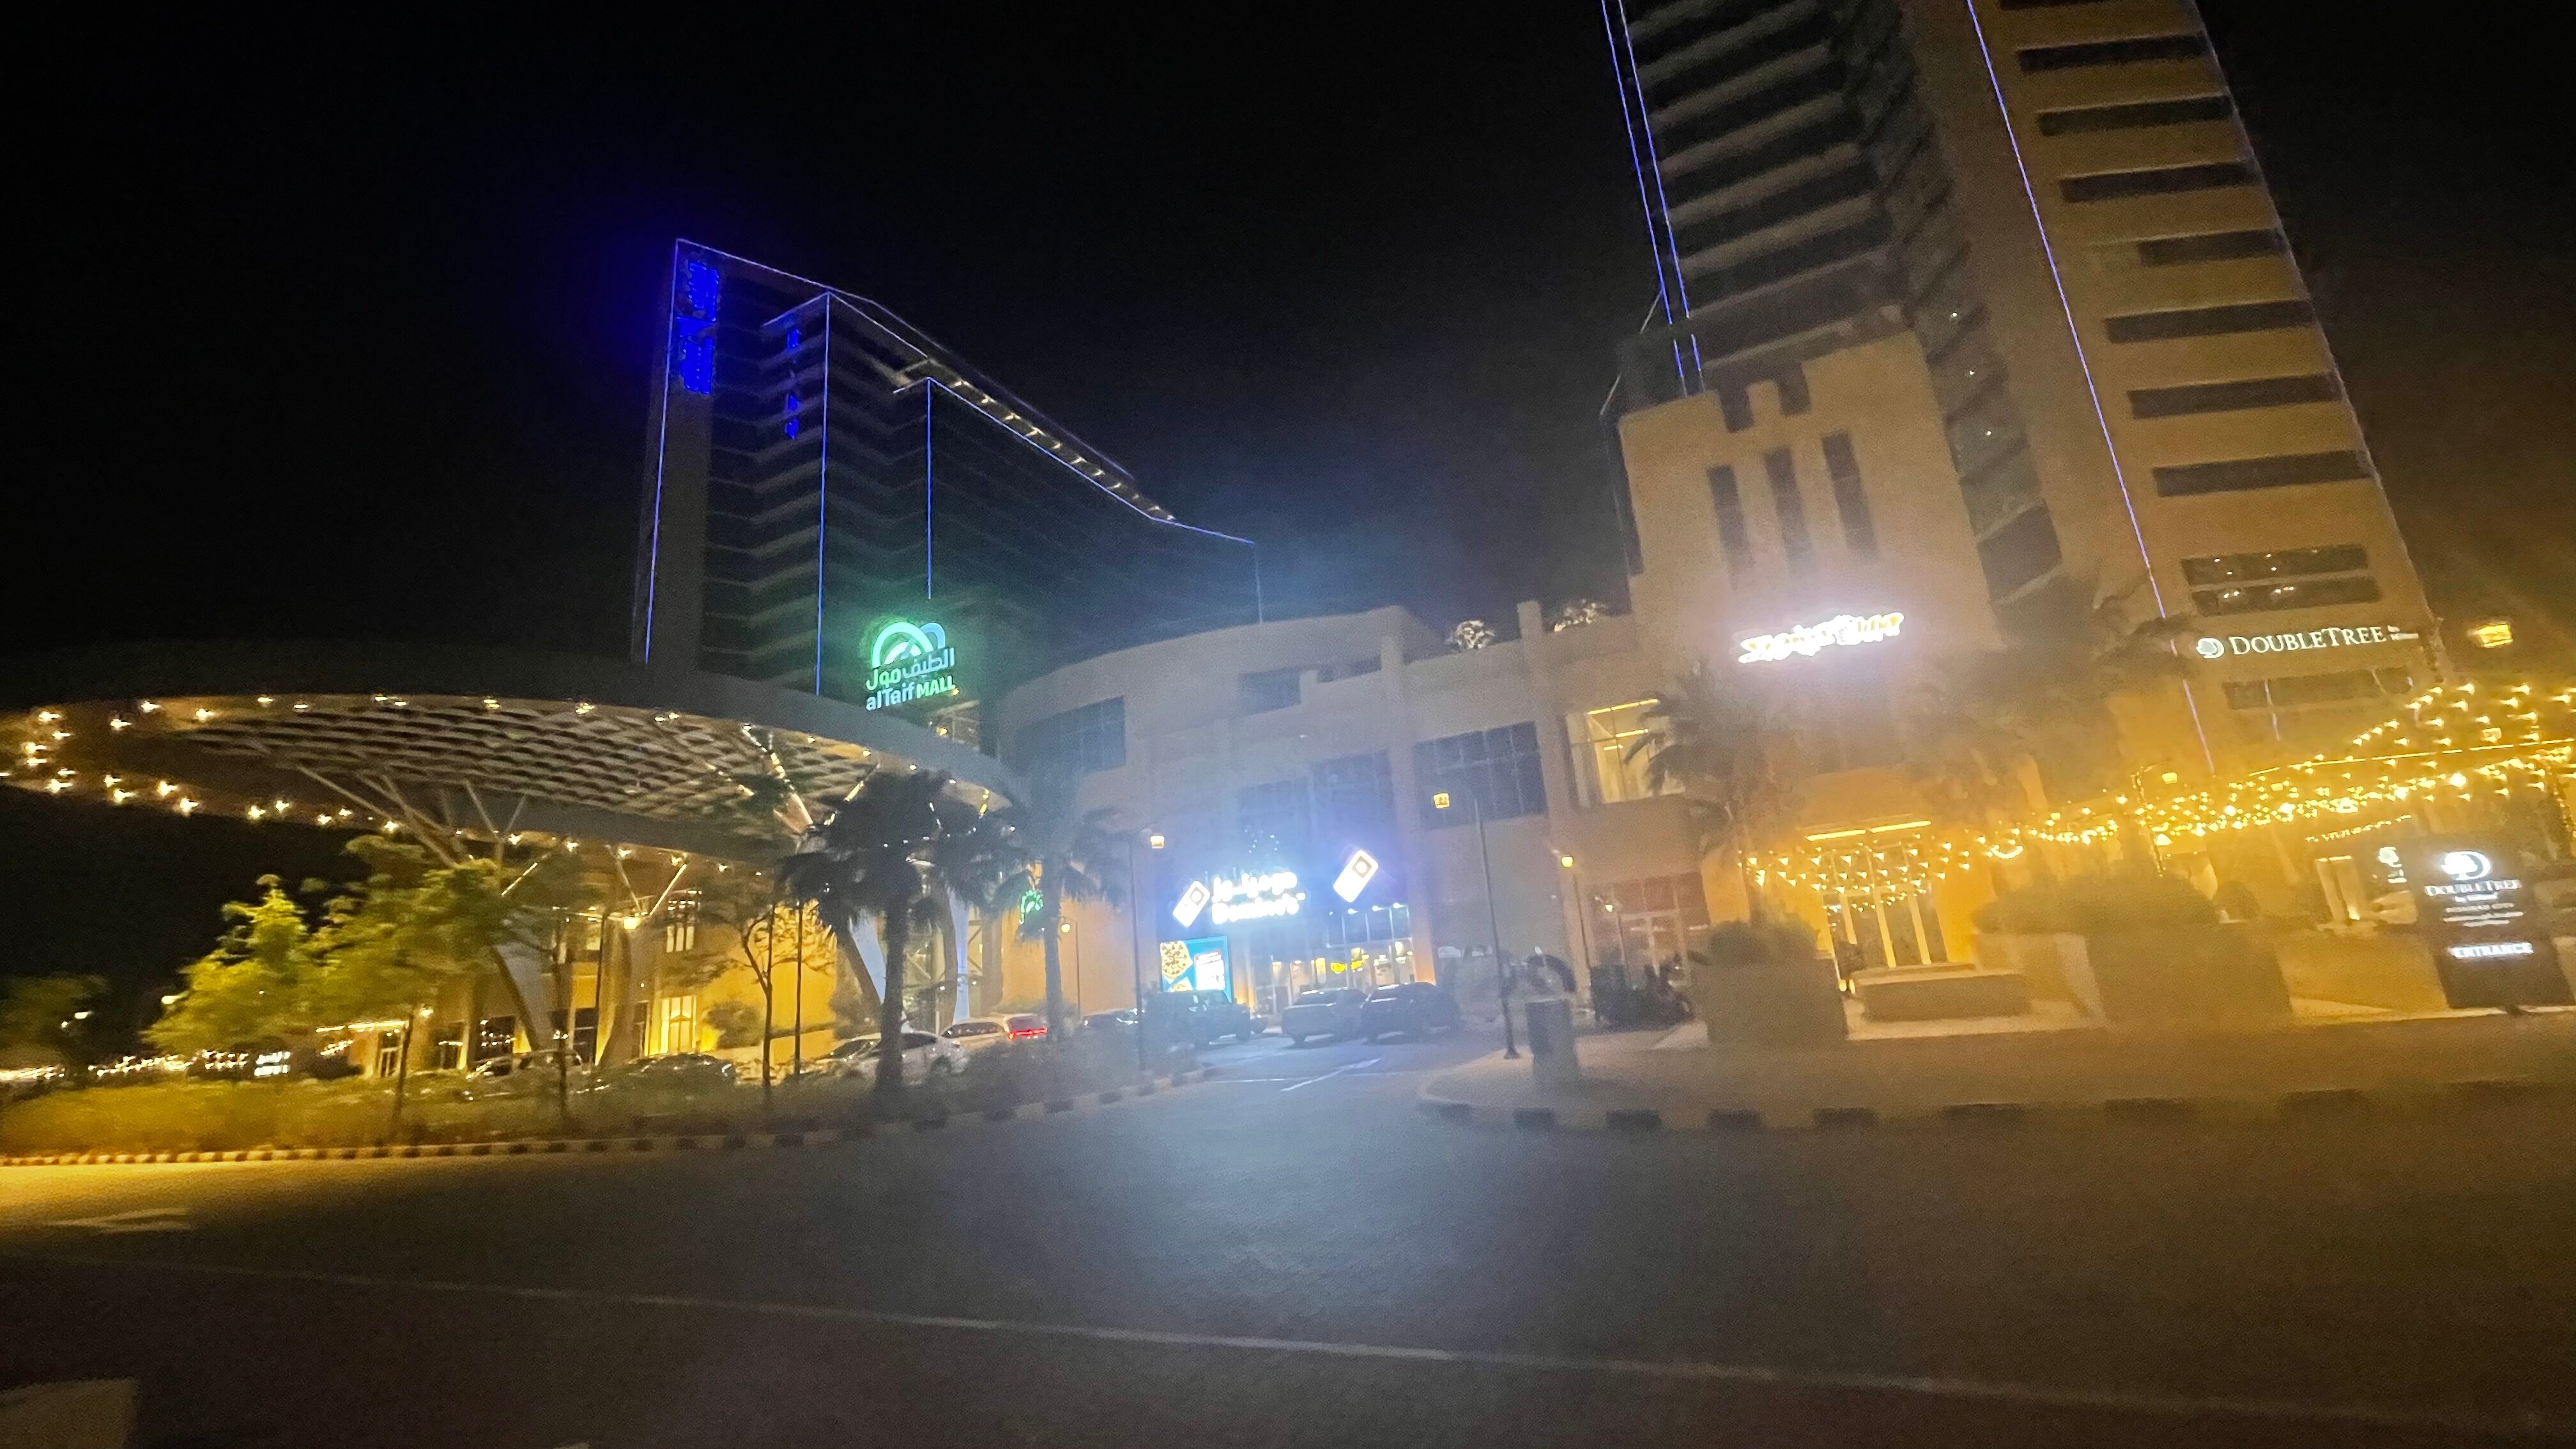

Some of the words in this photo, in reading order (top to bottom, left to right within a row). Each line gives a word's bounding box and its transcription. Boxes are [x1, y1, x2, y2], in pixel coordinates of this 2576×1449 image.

[2228, 625, 2387, 656] DOUBLETREE
[902, 647, 955, 678] الطيف
[866, 668, 901, 691] مول
[916, 674, 956, 699] MALL
[2451, 942, 2534, 959] ENTRANCE
